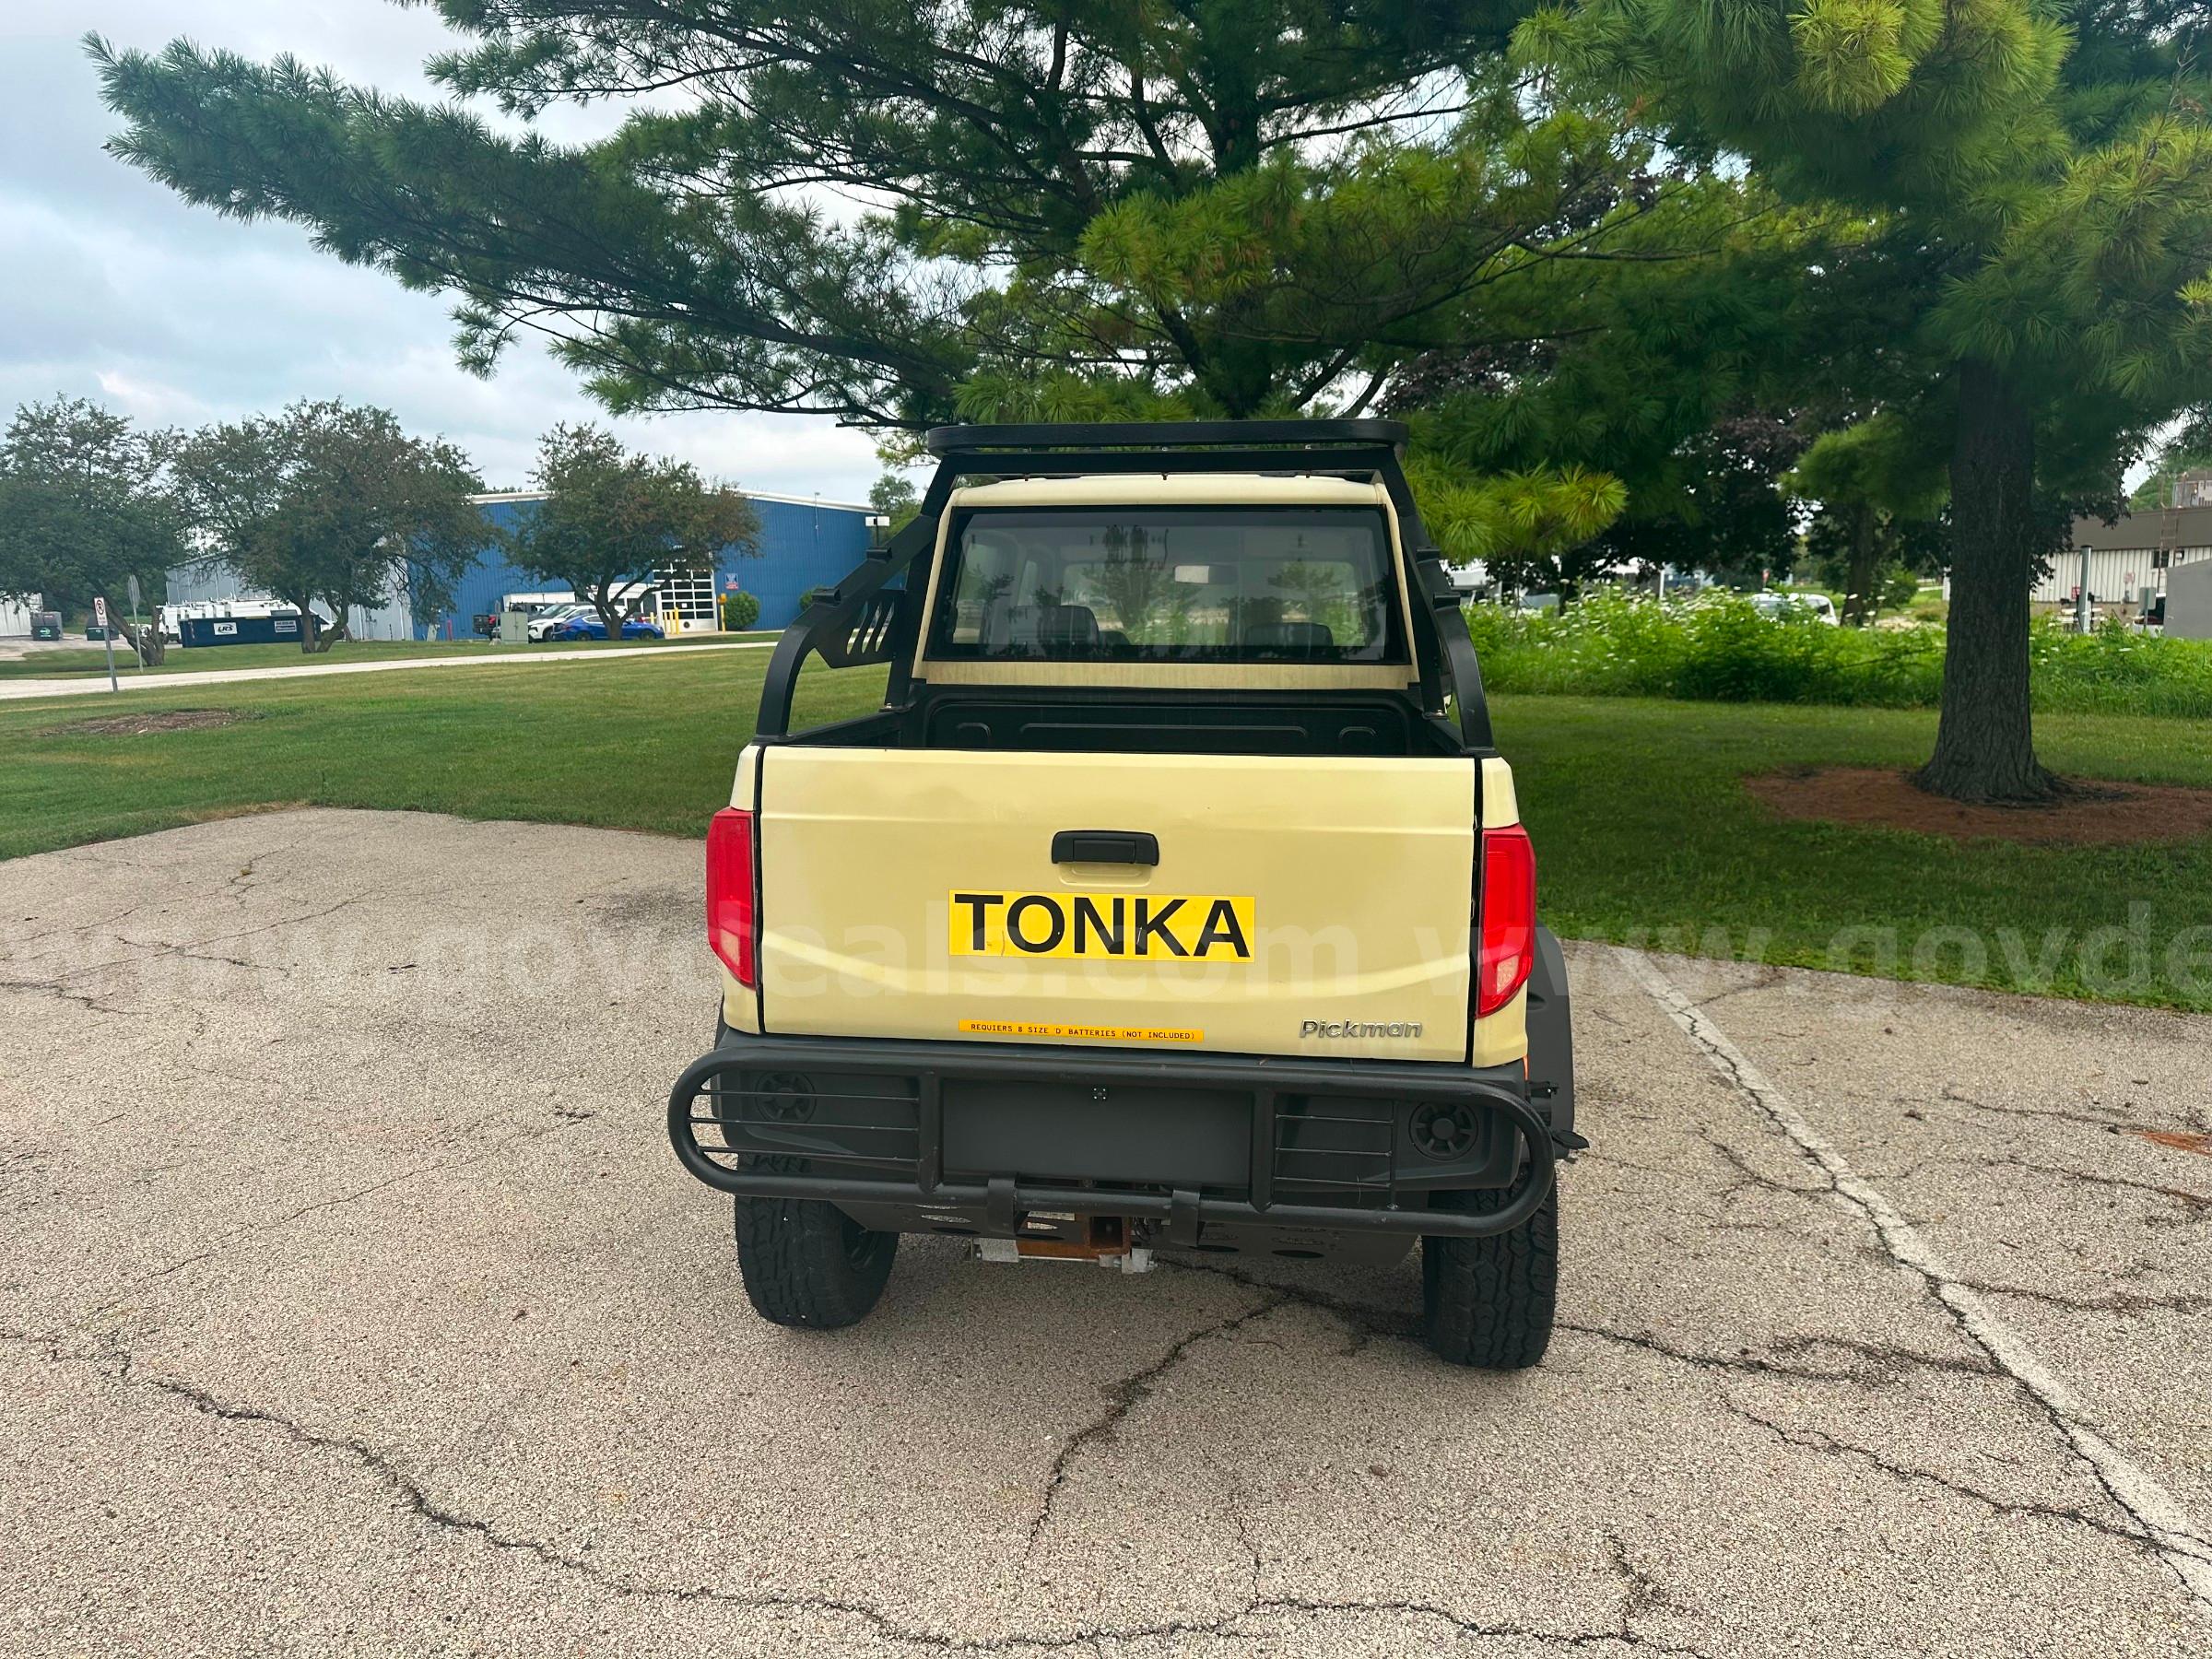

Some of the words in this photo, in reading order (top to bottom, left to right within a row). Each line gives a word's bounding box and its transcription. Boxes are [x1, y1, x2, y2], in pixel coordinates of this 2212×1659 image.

[954, 893, 1251, 959] TONKA
[971, 1023, 1013, 1032] REQUIERS
[1028, 1026, 1049, 1034] SIZE
[1068, 1029, 1116, 1037] BATTERIES
[1122, 1030, 1143, 1039] (NOT
[1147, 1031, 1195, 1040] INCLUDED)
[1299, 1018, 1423, 1039] Pickman
